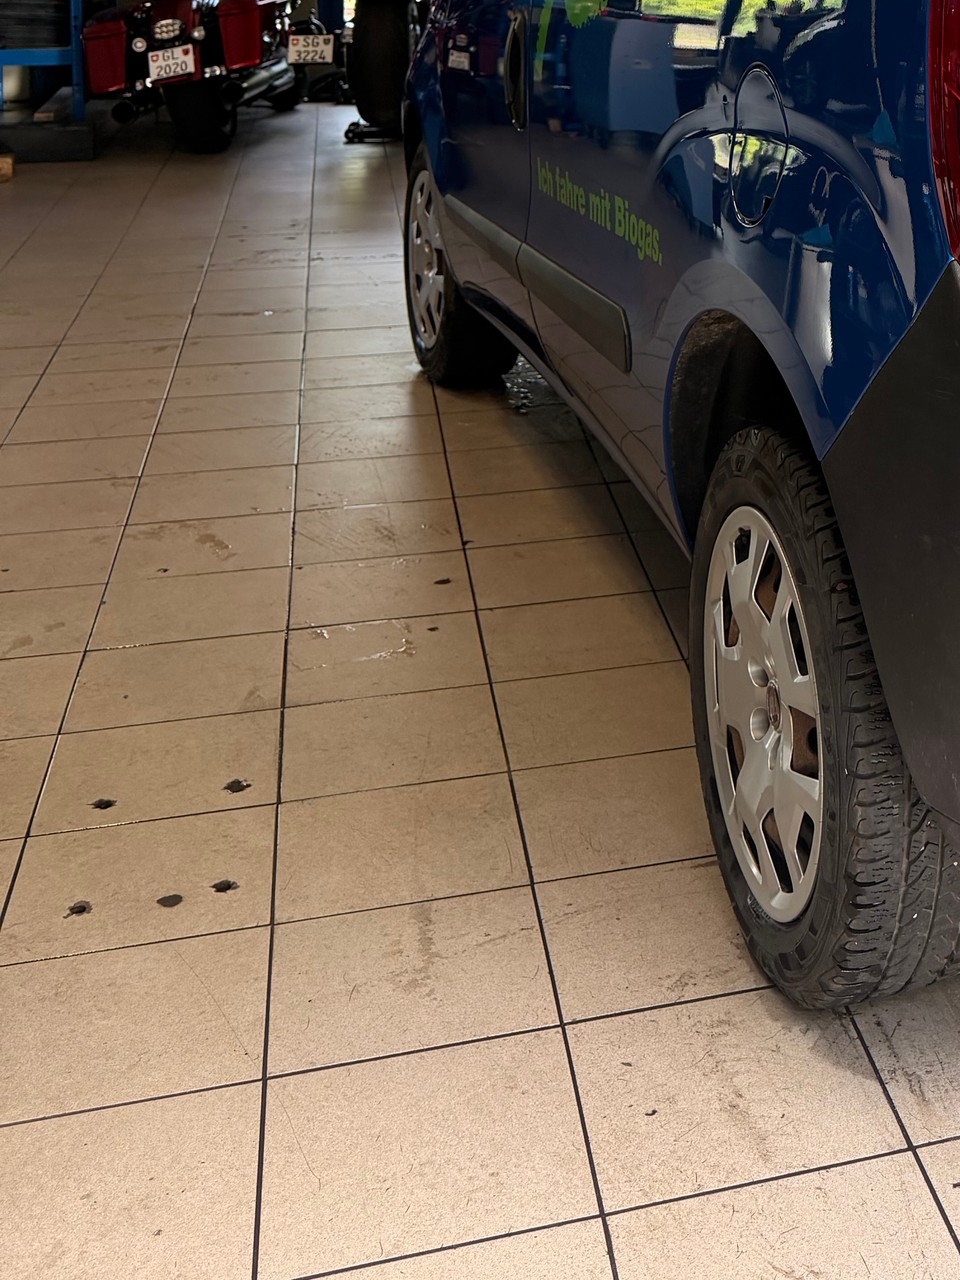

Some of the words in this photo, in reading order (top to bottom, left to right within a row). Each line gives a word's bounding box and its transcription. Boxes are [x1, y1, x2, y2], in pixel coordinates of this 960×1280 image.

[302, 36, 320, 47] SG
[162, 50, 179, 61] GL
[294, 50, 326, 62] 3224
[156, 61, 188, 77] 2020
[537, 156, 554, 197] Ich
[556, 166, 586, 215] fahre
[589, 188, 611, 231] mit
